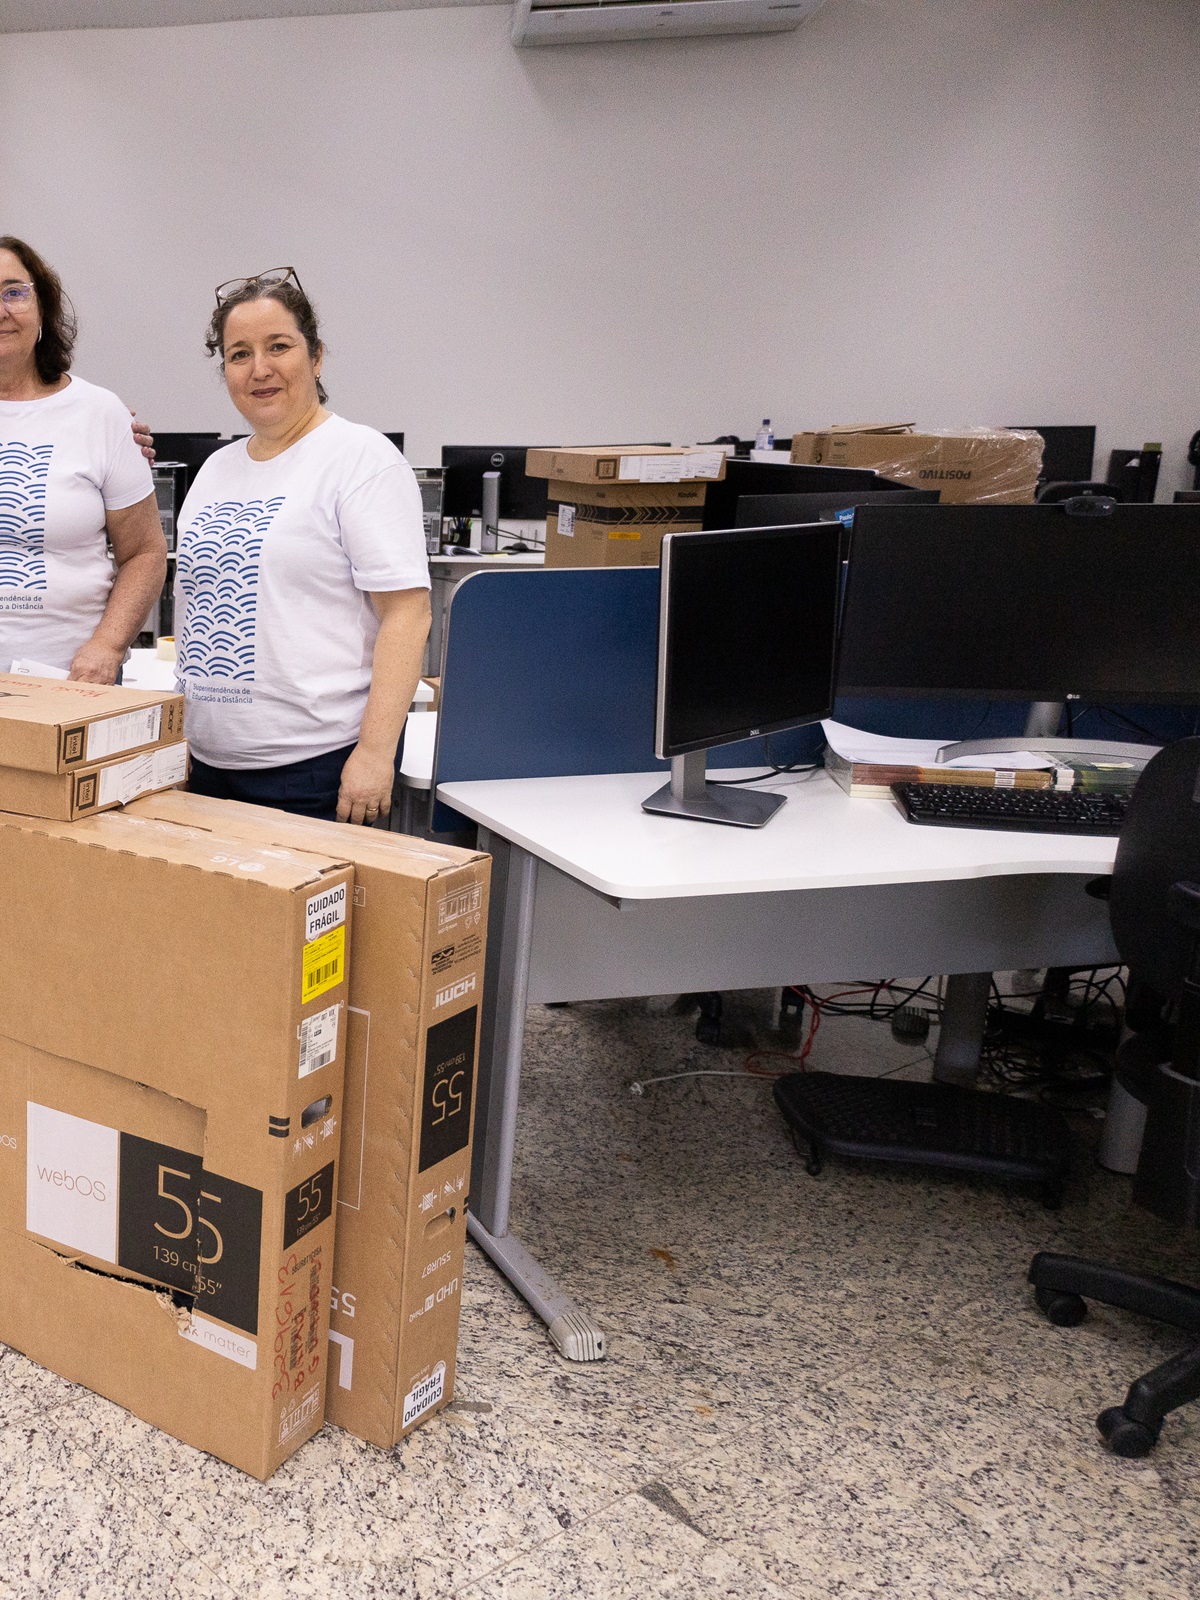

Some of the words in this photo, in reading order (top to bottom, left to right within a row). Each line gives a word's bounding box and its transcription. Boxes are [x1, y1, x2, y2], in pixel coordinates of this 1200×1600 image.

[918, 469, 972, 481] POSITIVO
[677, 491, 698, 499] Kodak
[11, 602, 44, 610] Distância
[191, 692, 216, 703] Educação
[221, 696, 253, 704] Distância
[193, 683, 241, 694] Superintendência
[168, 704, 176, 734] acer
[307, 888, 345, 916] CUIDADO
[309, 909, 339, 934] FRÁGIL
[434, 976, 476, 1009] HDMI
[431, 1070, 465, 1126] 55
[37, 1164, 107, 1202] webOS
[297, 1173, 322, 1221] 55
[154, 1164, 224, 1265] 55
[153, 1245, 179, 1267] 139
[421, 1250, 451, 1279] 55UR87
[436, 1277, 459, 1303] UHD
[408, 1307, 425, 1323] ThinQ
[203, 1331, 251, 1358] matter
[412, 1372, 442, 1402] FRÁGIL
[404, 1386, 443, 1423] CUIDADO
